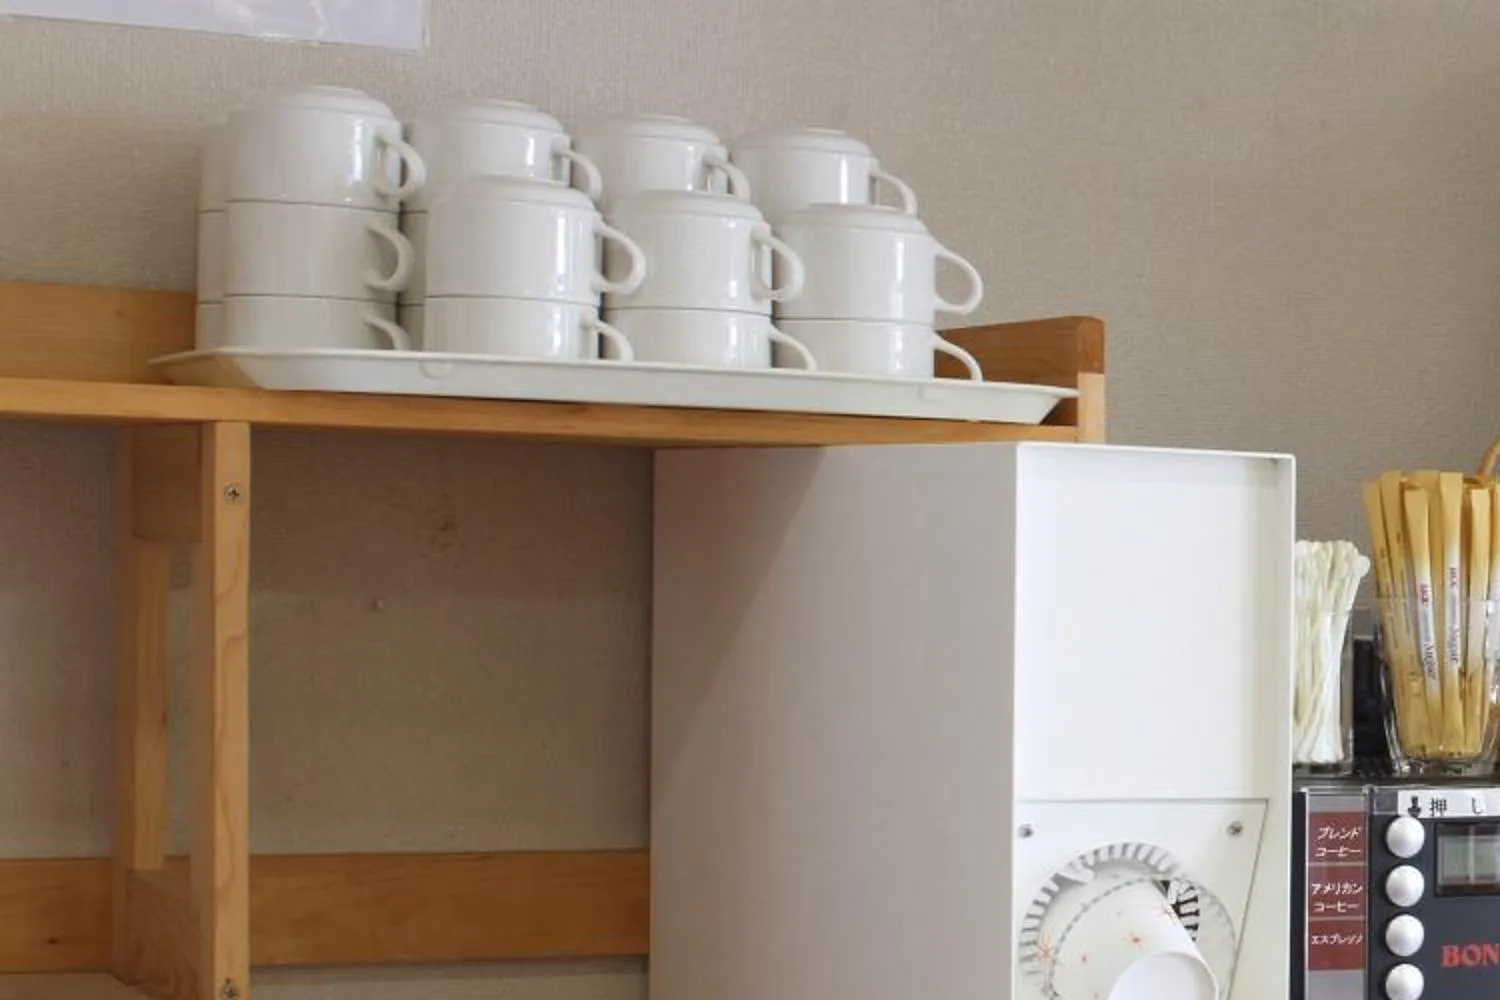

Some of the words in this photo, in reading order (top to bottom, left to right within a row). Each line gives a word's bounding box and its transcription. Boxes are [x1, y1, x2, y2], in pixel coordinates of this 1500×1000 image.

[1317, 826, 1362, 840] ブレンド
[1315, 846, 1361, 857] コーヒー
[1312, 882, 1363, 895] アメリカン
[1314, 903, 1360, 912] コーヒー
[1312, 934, 1363, 945] エスプレッソ
